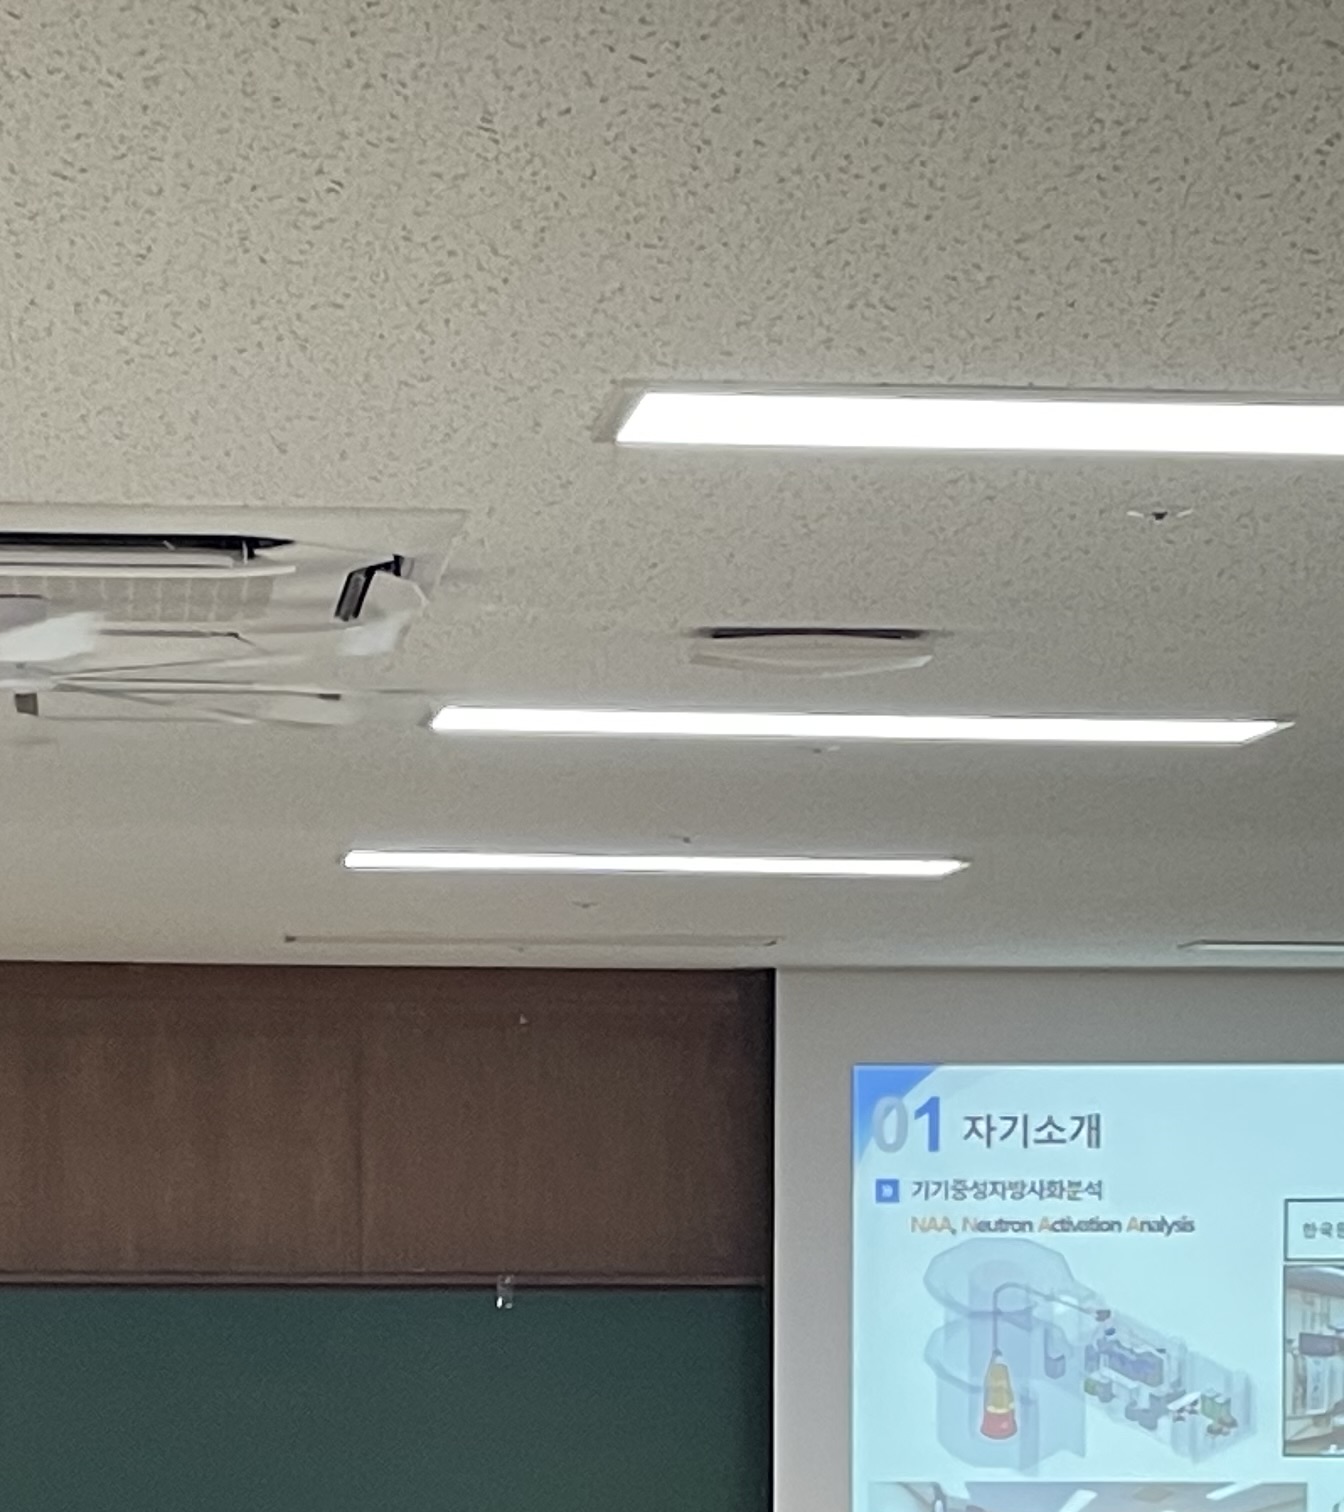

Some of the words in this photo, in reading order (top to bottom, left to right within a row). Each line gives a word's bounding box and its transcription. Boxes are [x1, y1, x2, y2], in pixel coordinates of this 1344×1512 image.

[872, 1096, 940, 1153] 01
[962, 1113, 1102, 1149] 자기소개
[911, 1180, 1103, 1201] 기기중성자방사화분석
[962, 1216, 1033, 1233] Neutron
[1038, 1216, 1122, 1233] Activation
[1126, 1216, 1195, 1236] Analysis
